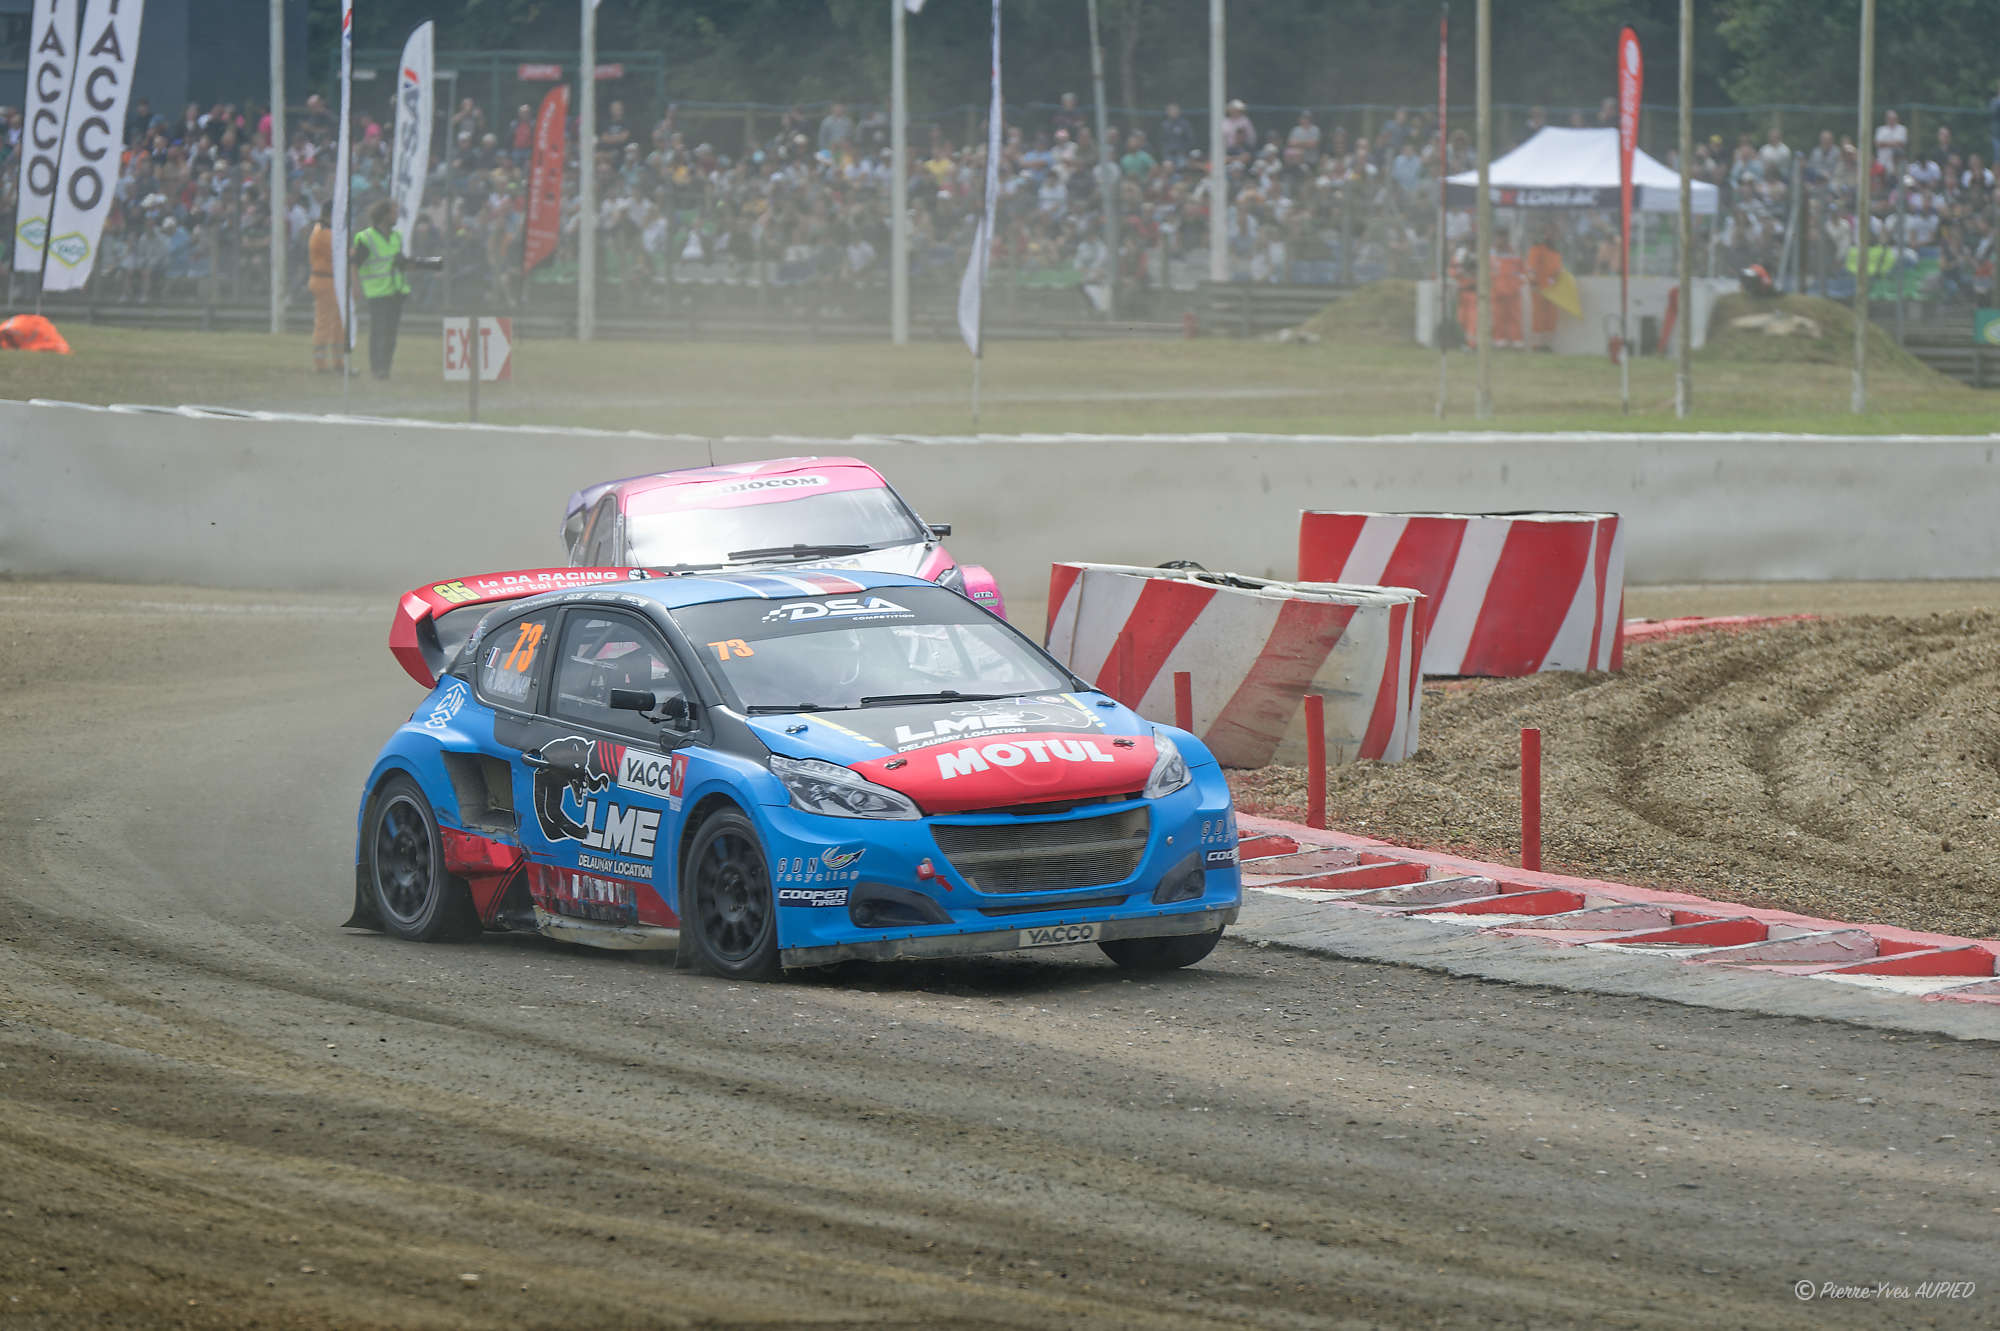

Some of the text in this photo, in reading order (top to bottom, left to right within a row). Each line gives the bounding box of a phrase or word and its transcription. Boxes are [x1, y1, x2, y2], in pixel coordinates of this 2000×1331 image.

[446, 328, 491, 370] EXT
[489, 585, 526, 596] avec
[529, 582, 552, 591] toi
[502, 575, 531, 585] DA
[537, 571, 618, 583] RACING
[790, 596, 911, 620] DSA
[852, 613, 915, 622] COMPETITION
[504, 622, 545, 672] 73
[707, 638, 754, 662] 73
[894, 714, 1025, 744] LME
[897, 727, 1027, 754] DELAUNAY LOCATION
[936, 738, 1114, 780] MOTUL
[626, 757, 671, 791] YACC
[582, 797, 662, 860] LME
[578, 854, 653, 879] DELAUNAY LOCATION
[776, 870, 859, 883] recycling
[779, 889, 848, 900] COOPER
[810, 898, 847, 907] TIRES
[1028, 925, 1094, 944] YACCO
